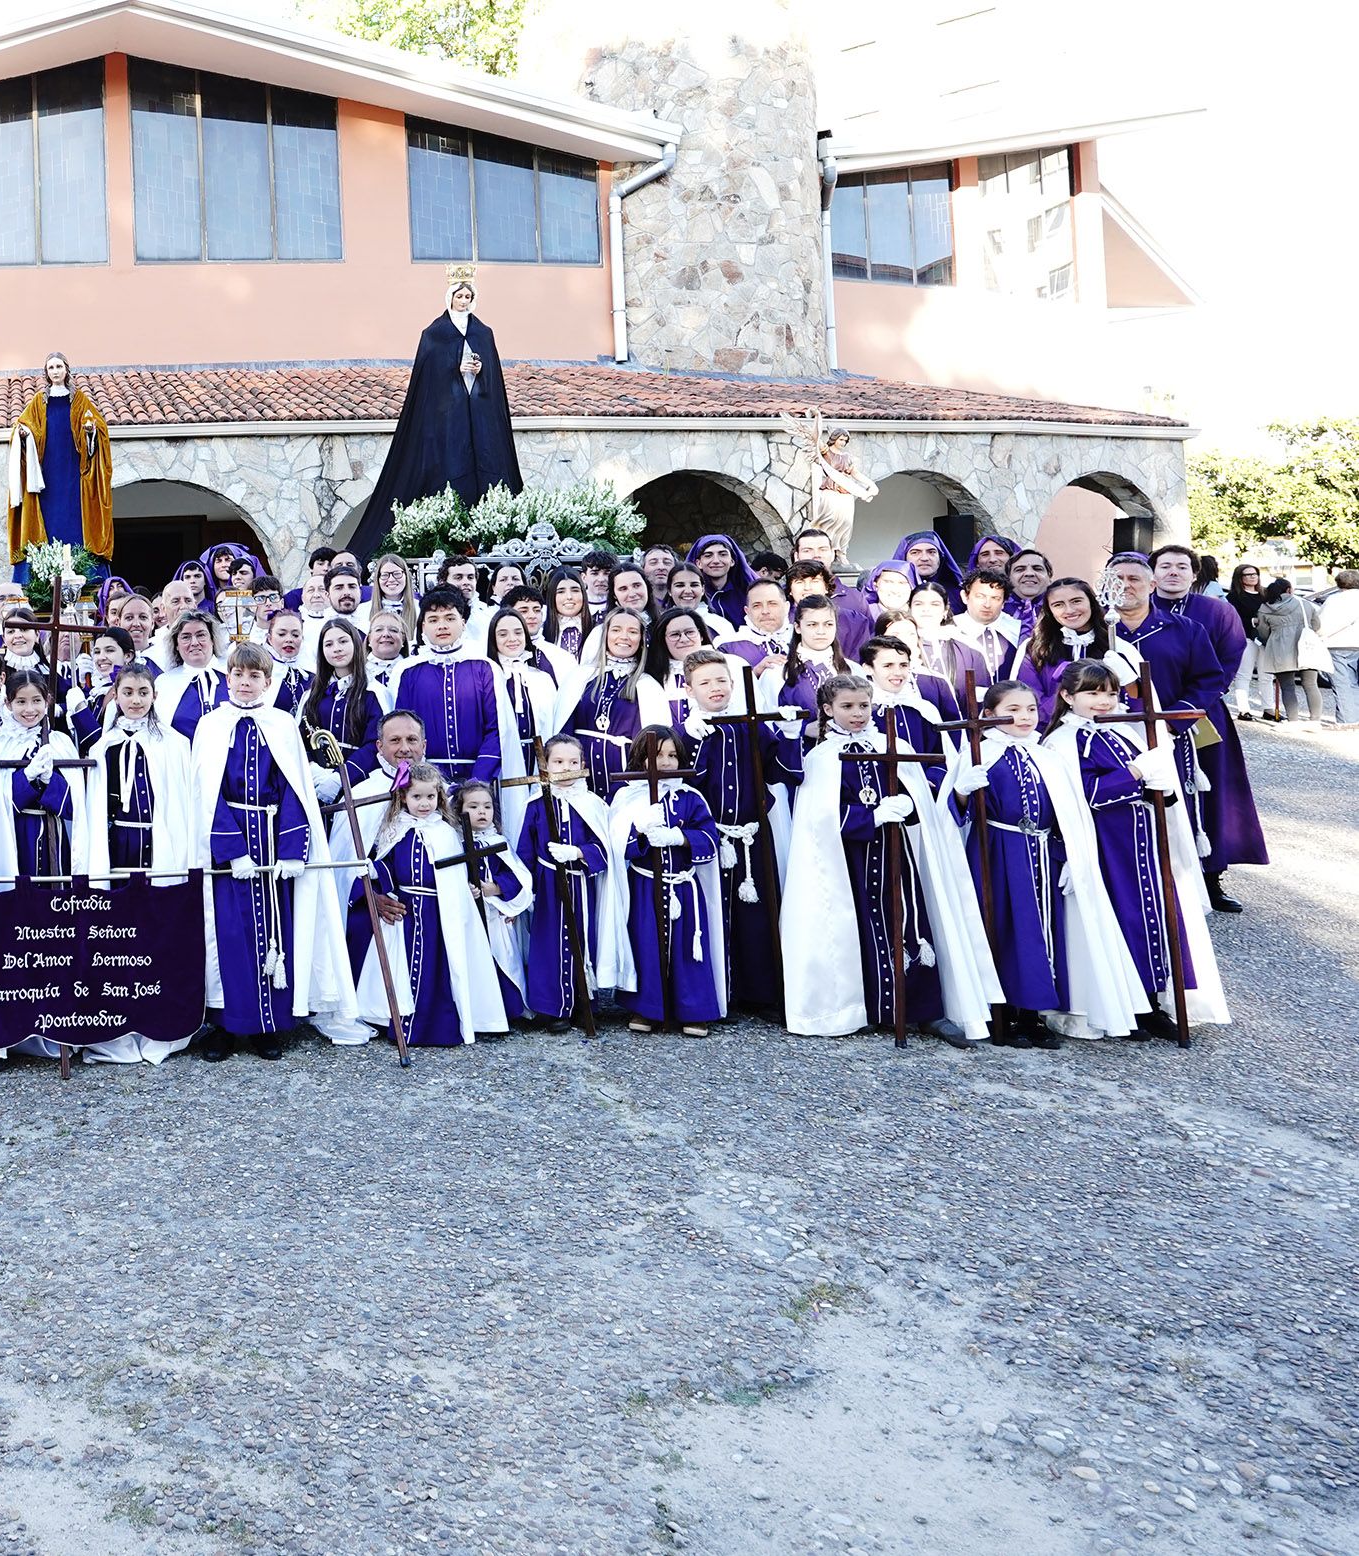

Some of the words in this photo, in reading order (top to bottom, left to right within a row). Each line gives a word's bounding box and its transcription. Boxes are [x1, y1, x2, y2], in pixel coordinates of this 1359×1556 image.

[50, 895, 112, 915] Cofradía
[14, 925, 76, 941] Nuestra
[87, 924, 137, 940] Señora
[2, 952, 32, 970] Del
[32, 952, 74, 969] Amor
[73, 981, 90, 998] de
[100, 981, 129, 998] San
[131, 980, 162, 1000] José
